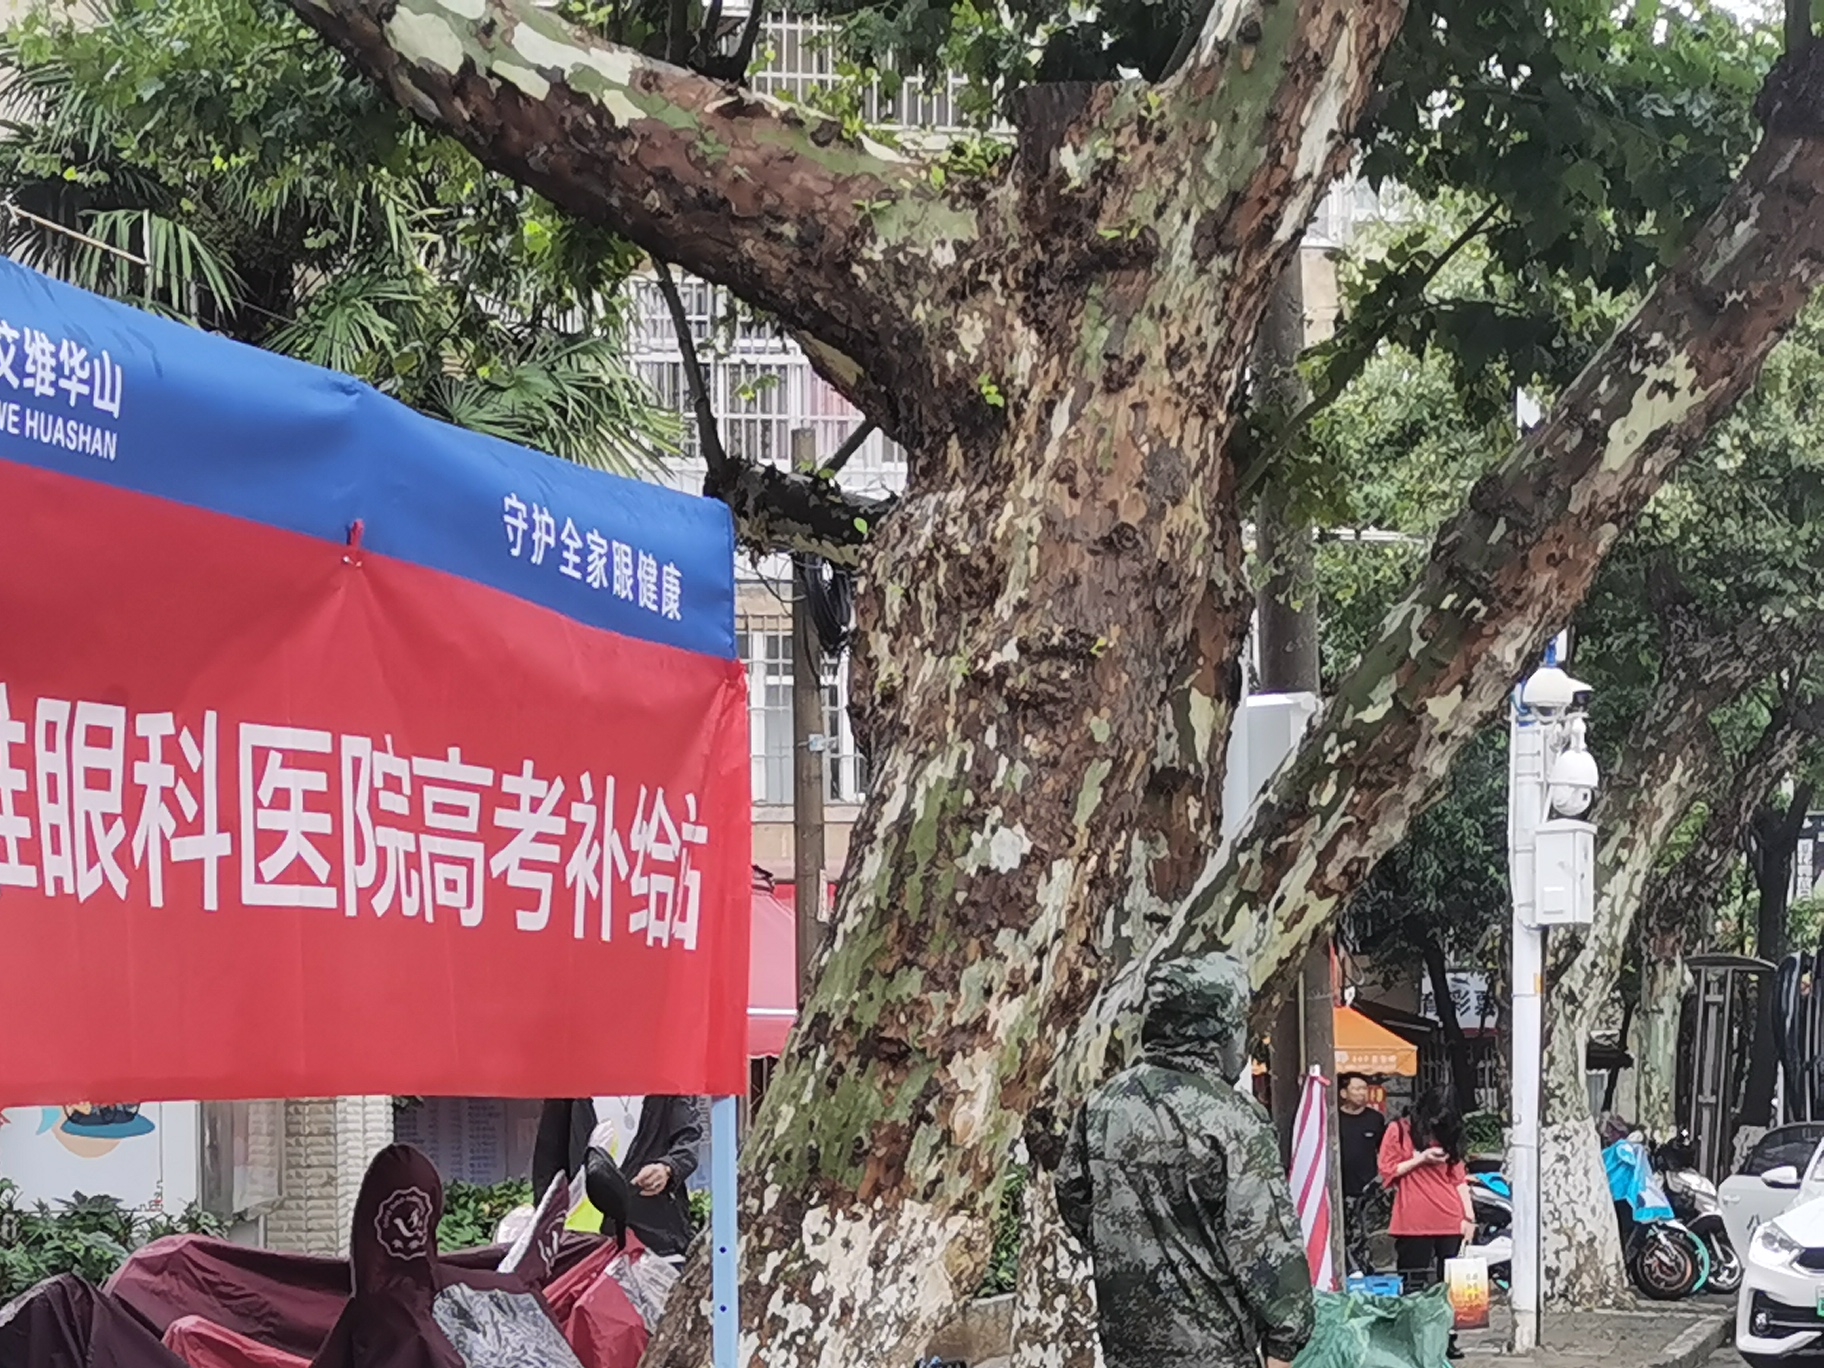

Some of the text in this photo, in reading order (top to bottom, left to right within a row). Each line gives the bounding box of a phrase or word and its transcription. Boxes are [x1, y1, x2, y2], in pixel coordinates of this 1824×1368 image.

[25, 409, 117, 462] HUASHAN
[502, 492, 683, 622] 守护全家眼健康
